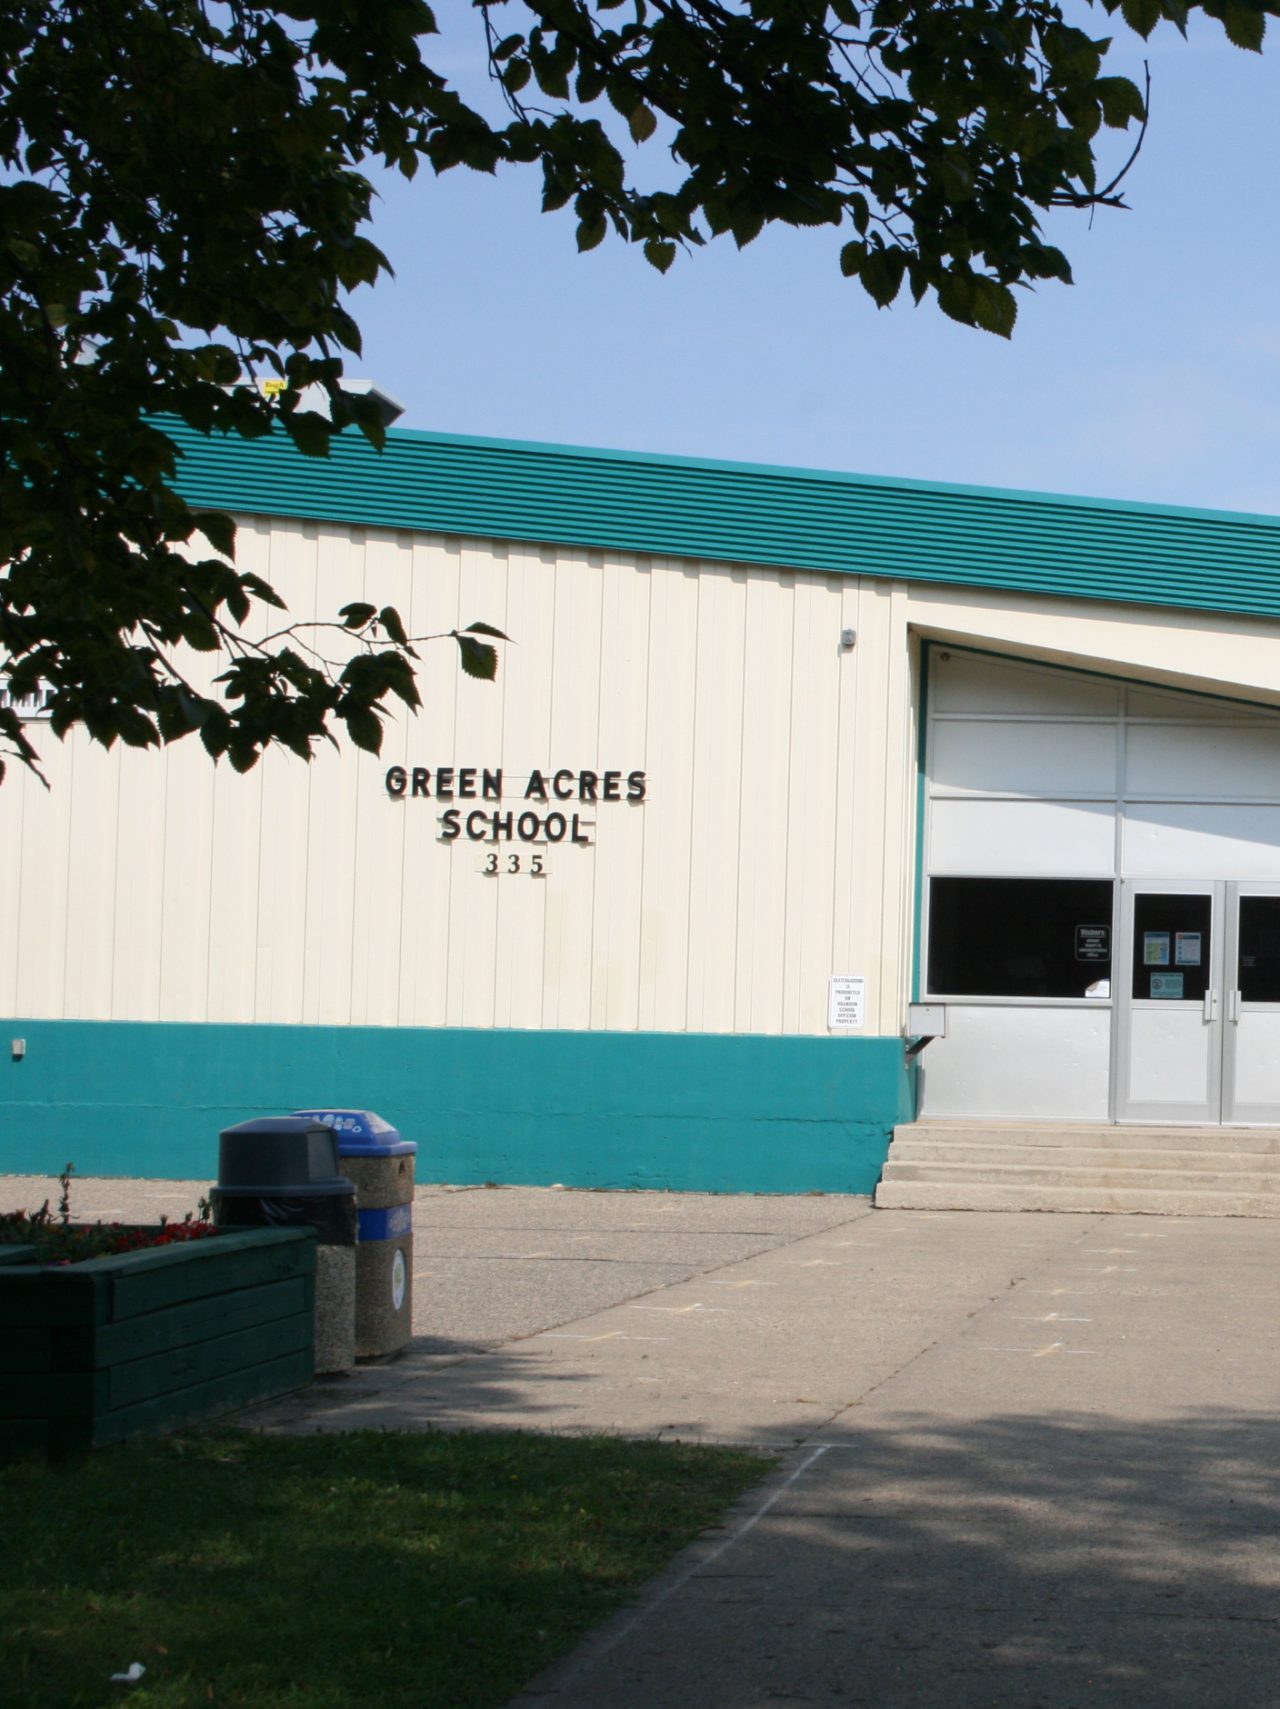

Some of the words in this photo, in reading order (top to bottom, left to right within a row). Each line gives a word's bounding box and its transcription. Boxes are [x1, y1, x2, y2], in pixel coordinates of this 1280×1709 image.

[385, 766, 503, 798] GREEN
[524, 769, 647, 801] ACRES
[441, 809, 589, 843] SCHOOL
[486, 853, 543, 873] 335
